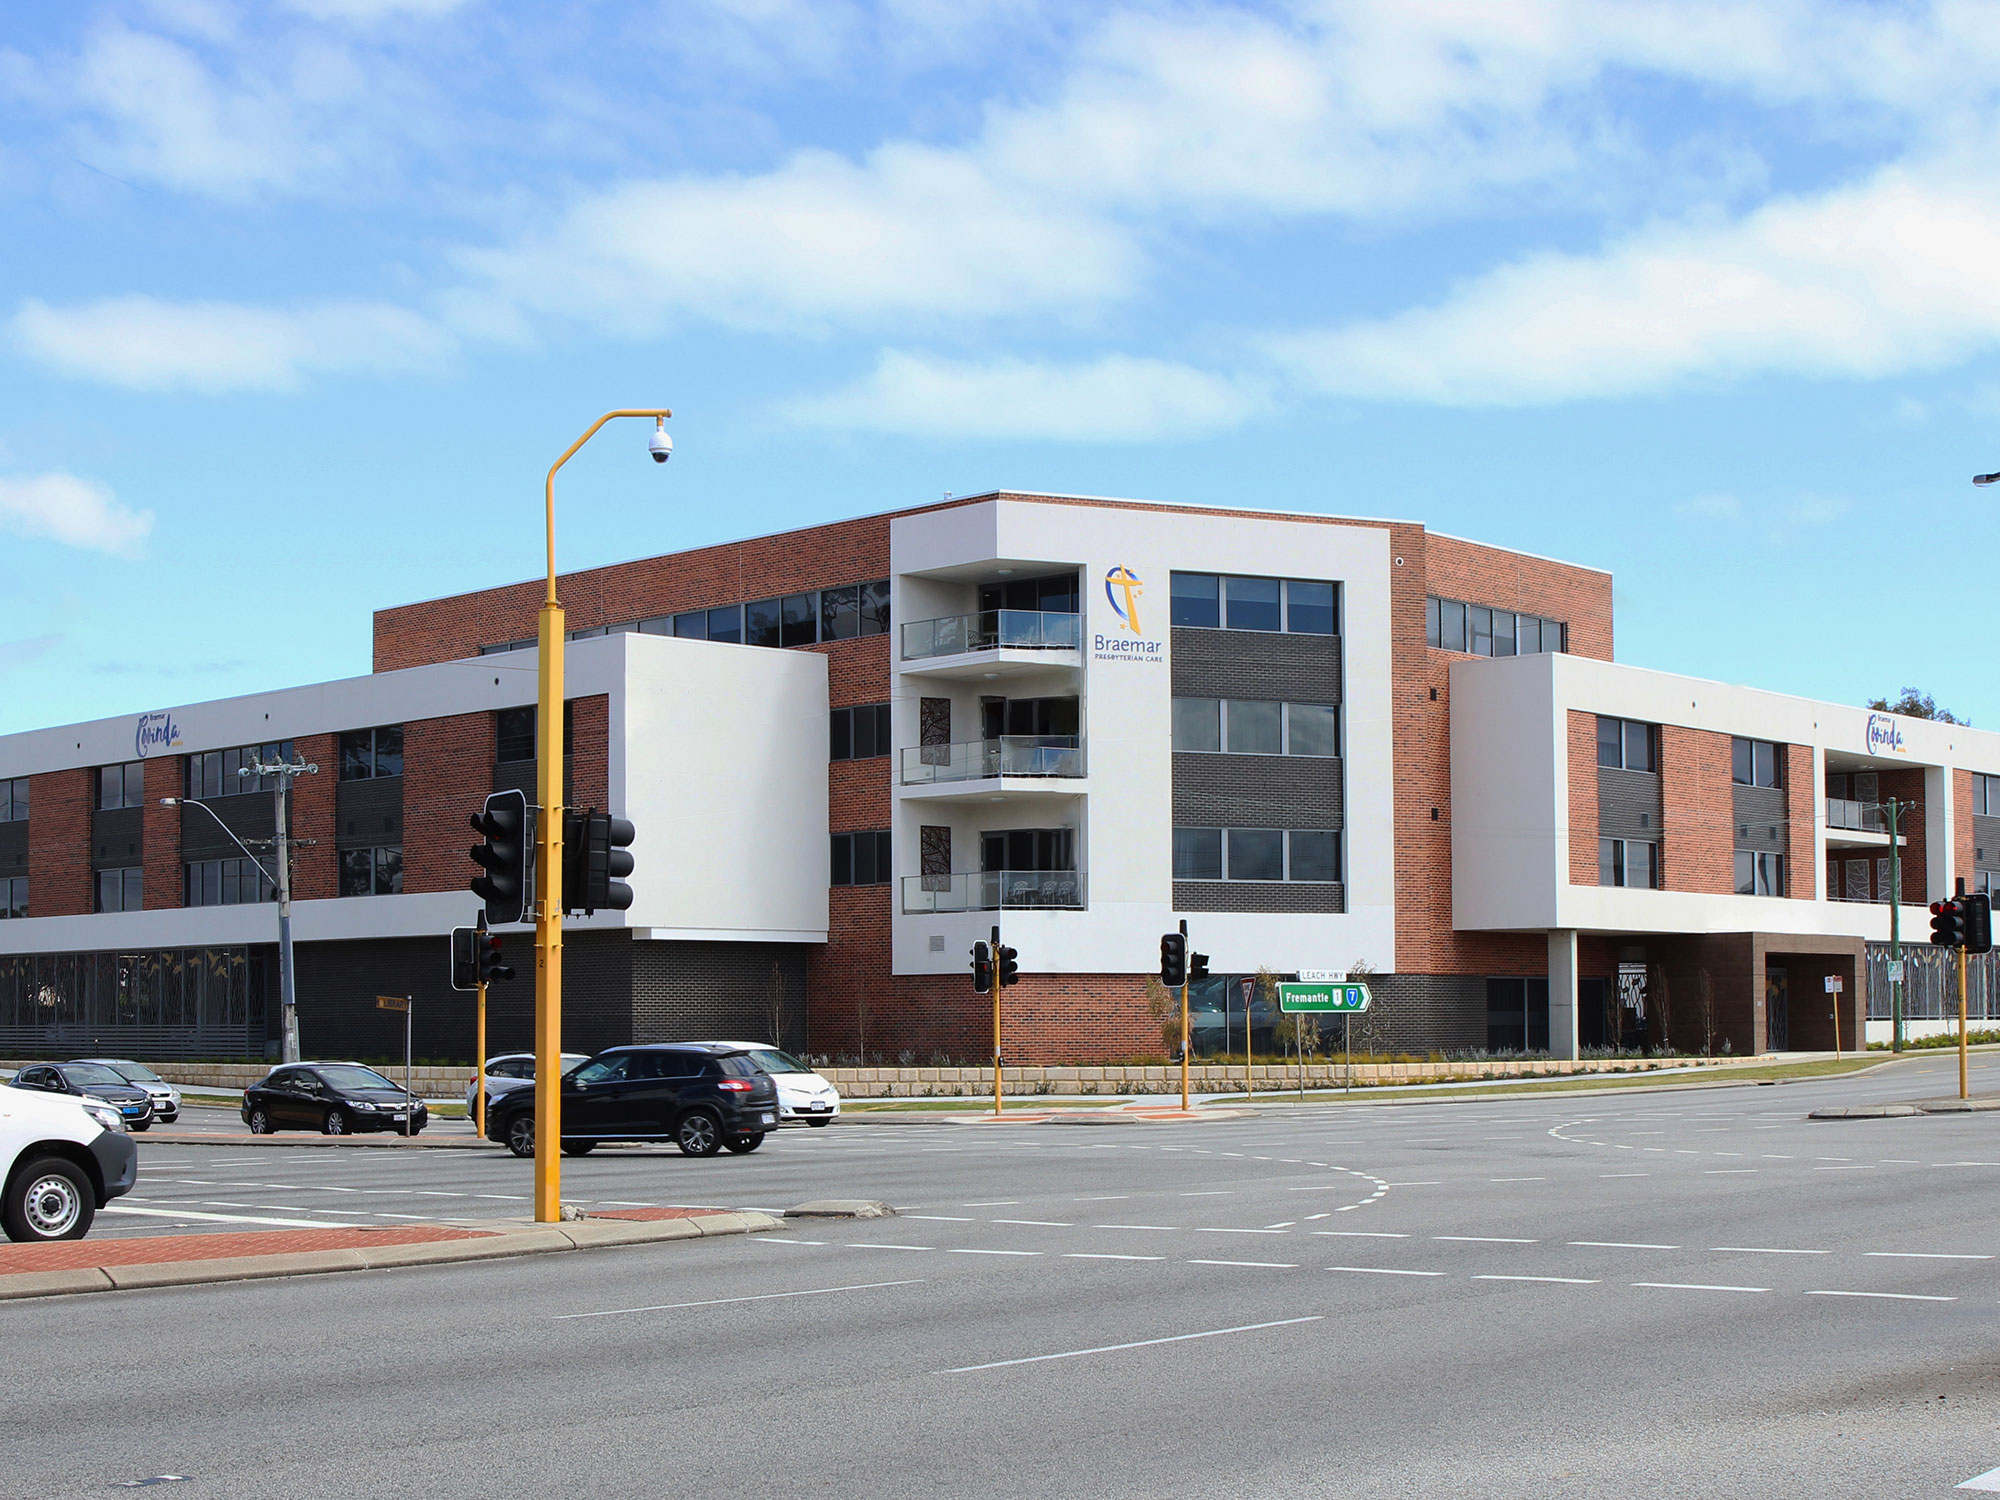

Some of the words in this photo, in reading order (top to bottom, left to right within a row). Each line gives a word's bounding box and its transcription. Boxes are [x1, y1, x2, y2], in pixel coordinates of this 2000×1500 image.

[1095, 634, 1162, 653] Braemar
[1094, 653, 1143, 662] PRESBYTERIAN
[1145, 655, 1163, 663] CARE
[1302, 971, 1326, 980] LEACH
[1328, 971, 1344, 980] HWY
[1285, 992, 1329, 1003] Fremantle
